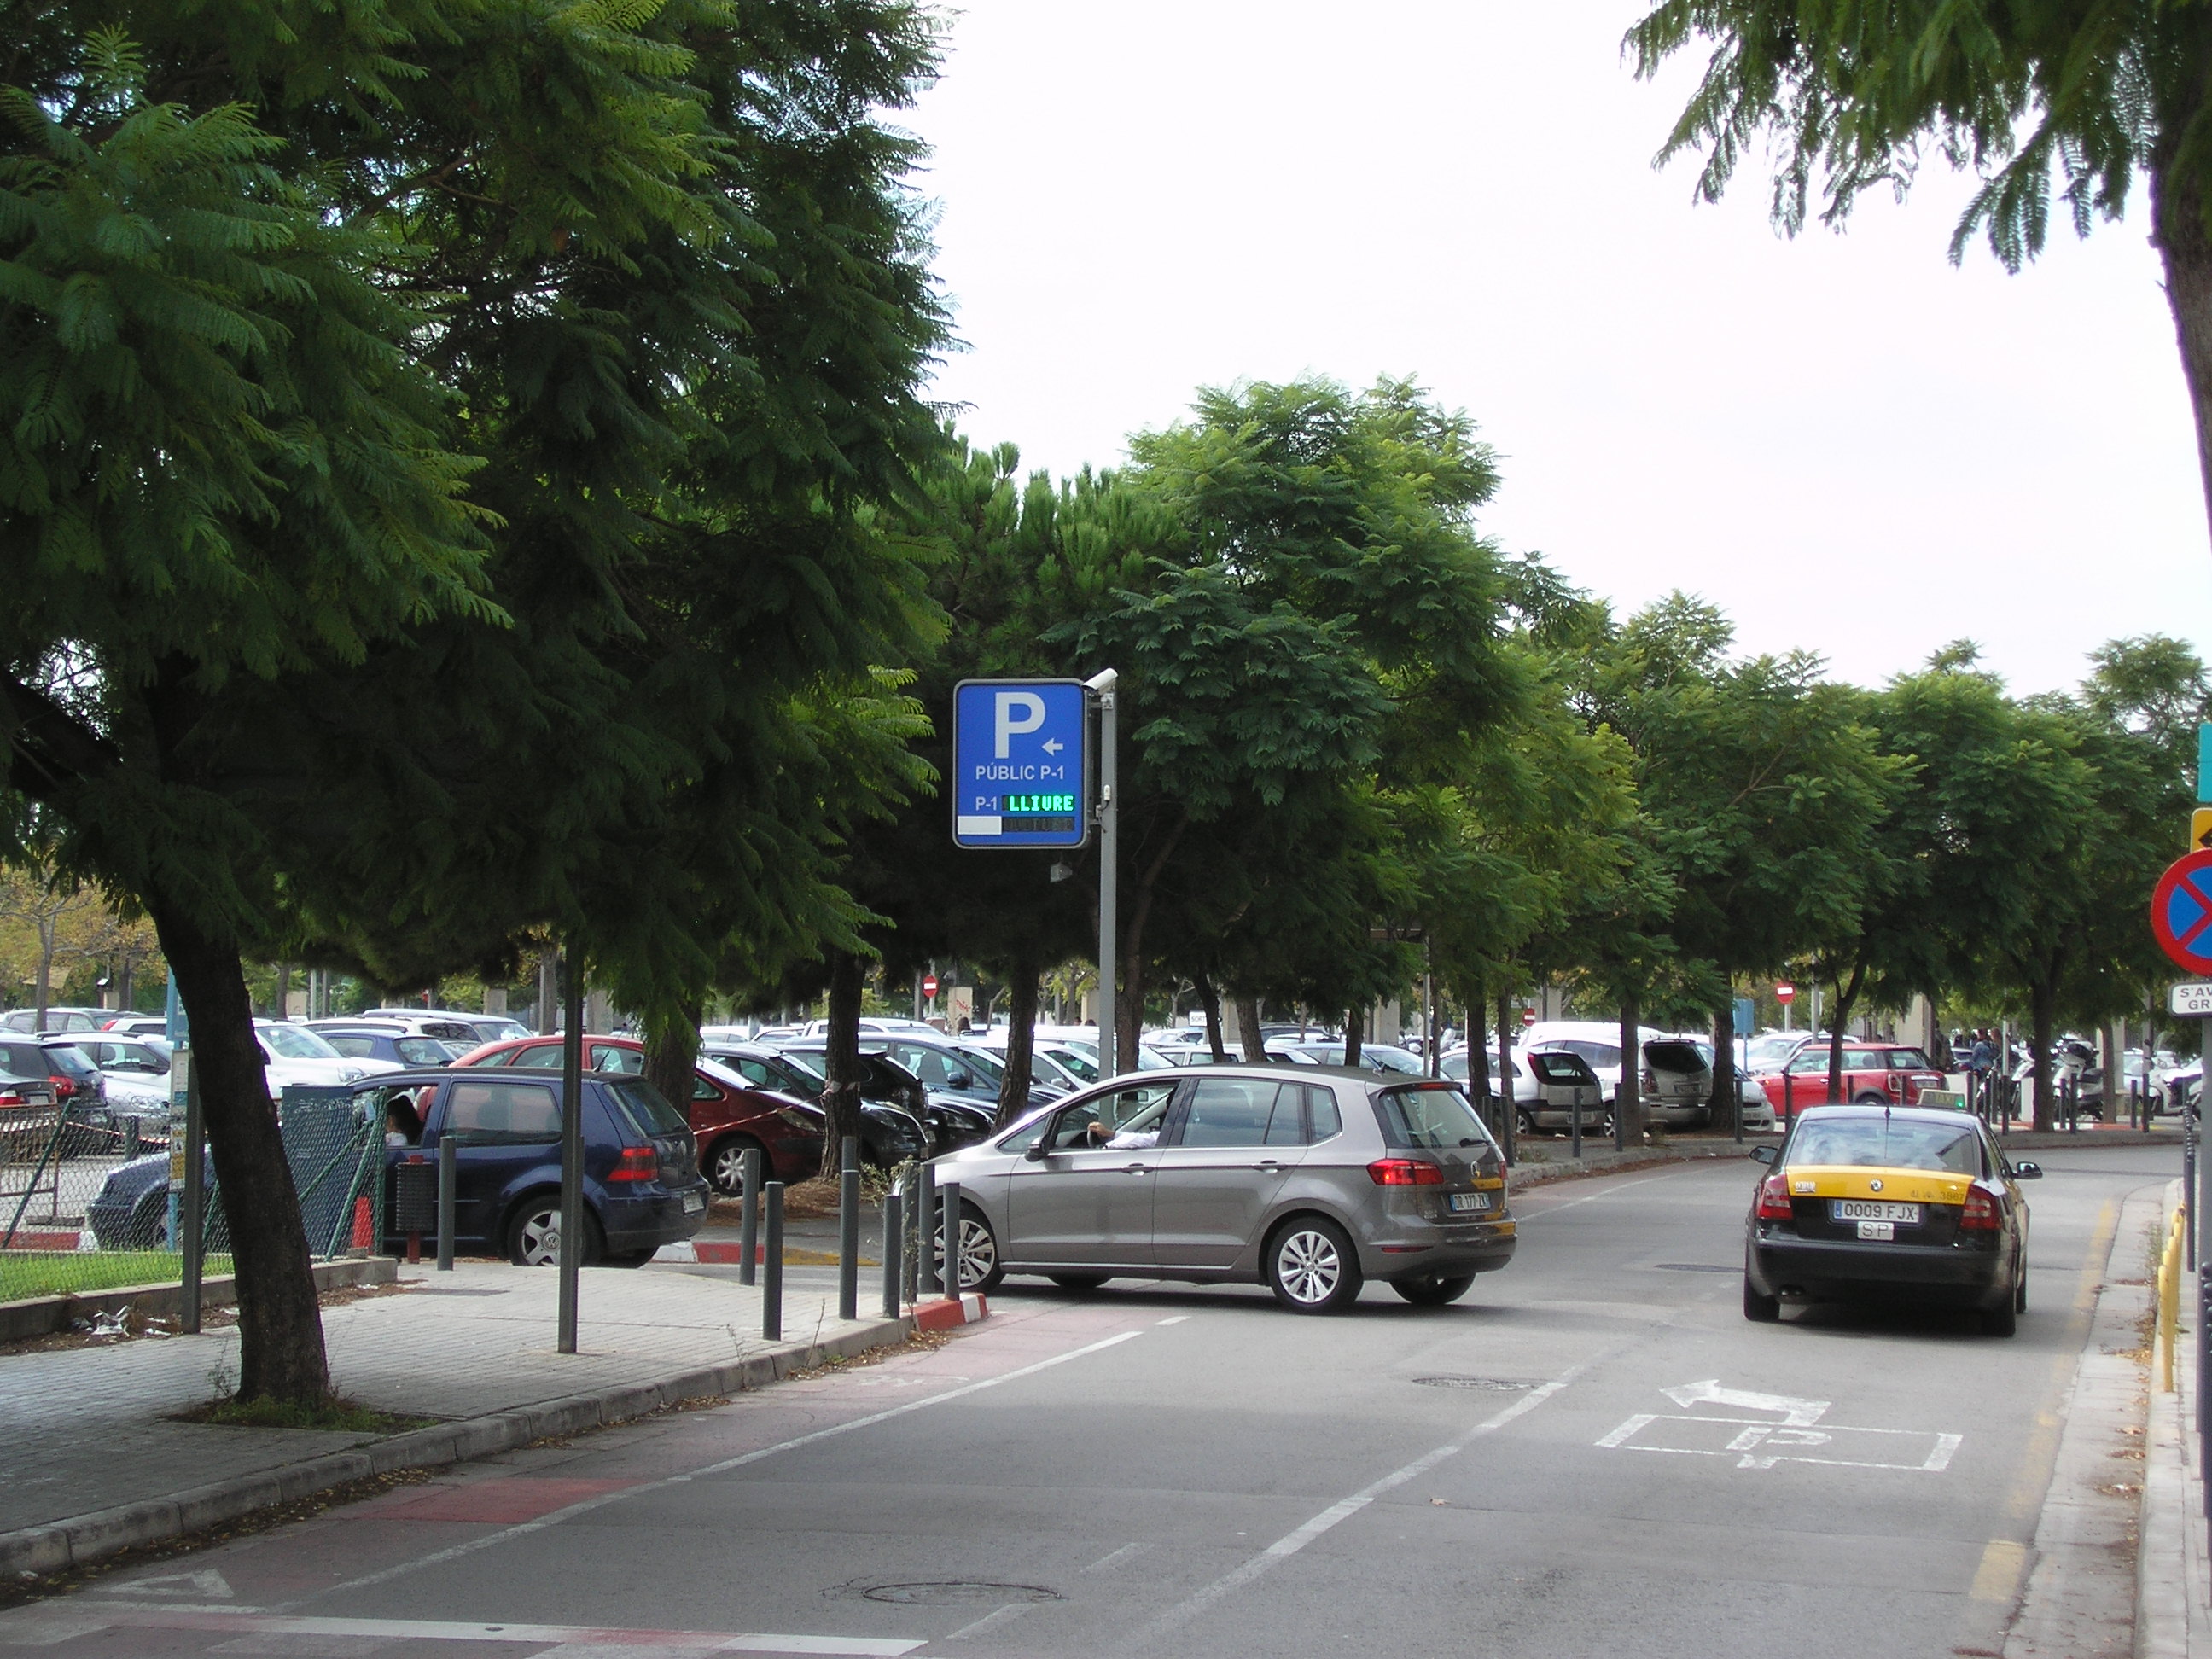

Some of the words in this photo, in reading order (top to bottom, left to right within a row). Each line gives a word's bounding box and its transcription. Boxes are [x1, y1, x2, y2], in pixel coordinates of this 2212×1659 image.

[995, 692, 1045, 759] P
[975, 763, 1035, 780] PÚBLIC
[1040, 765, 1064, 780] P-1
[975, 796, 997, 811] P-1
[1844, 1203, 1881, 1218] 0009
[1886, 1205, 1915, 1220] FJX
[1862, 1224, 1889, 1237] SP
